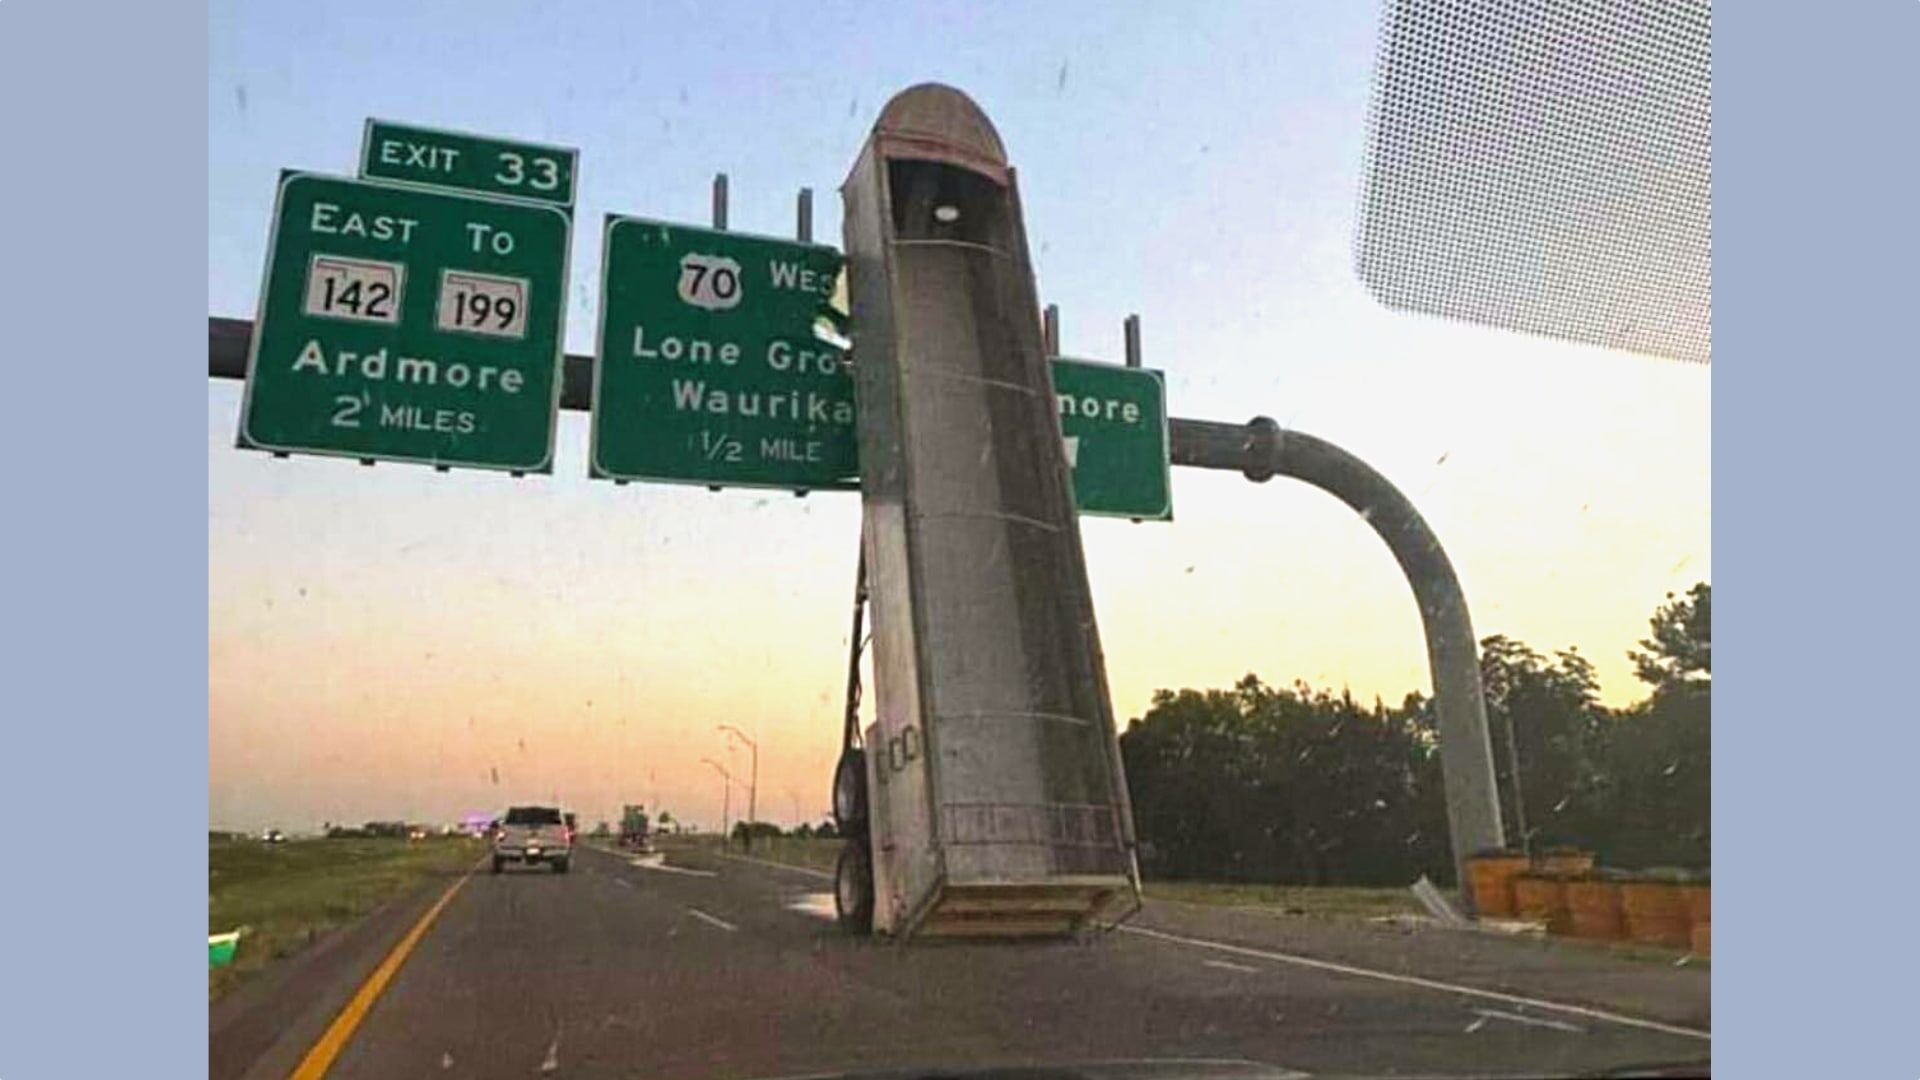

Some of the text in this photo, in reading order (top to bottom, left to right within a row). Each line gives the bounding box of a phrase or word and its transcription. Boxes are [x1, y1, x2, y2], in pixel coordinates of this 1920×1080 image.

[381, 140, 559, 191] EXIT 33
[310, 202, 419, 244] EAST
[322, 277, 391, 318] 142
[685, 259, 832, 299] 70 WES
[454, 291, 516, 329] 199
[292, 340, 525, 393] Ardmore
[633, 326, 837, 375] Lone Gro
[331, 396, 476, 433] 2 MILES
[672, 379, 852, 423] Waurika
[1056, 394, 1140, 423] more
[702, 431, 822, 462] 1/2 MILE
